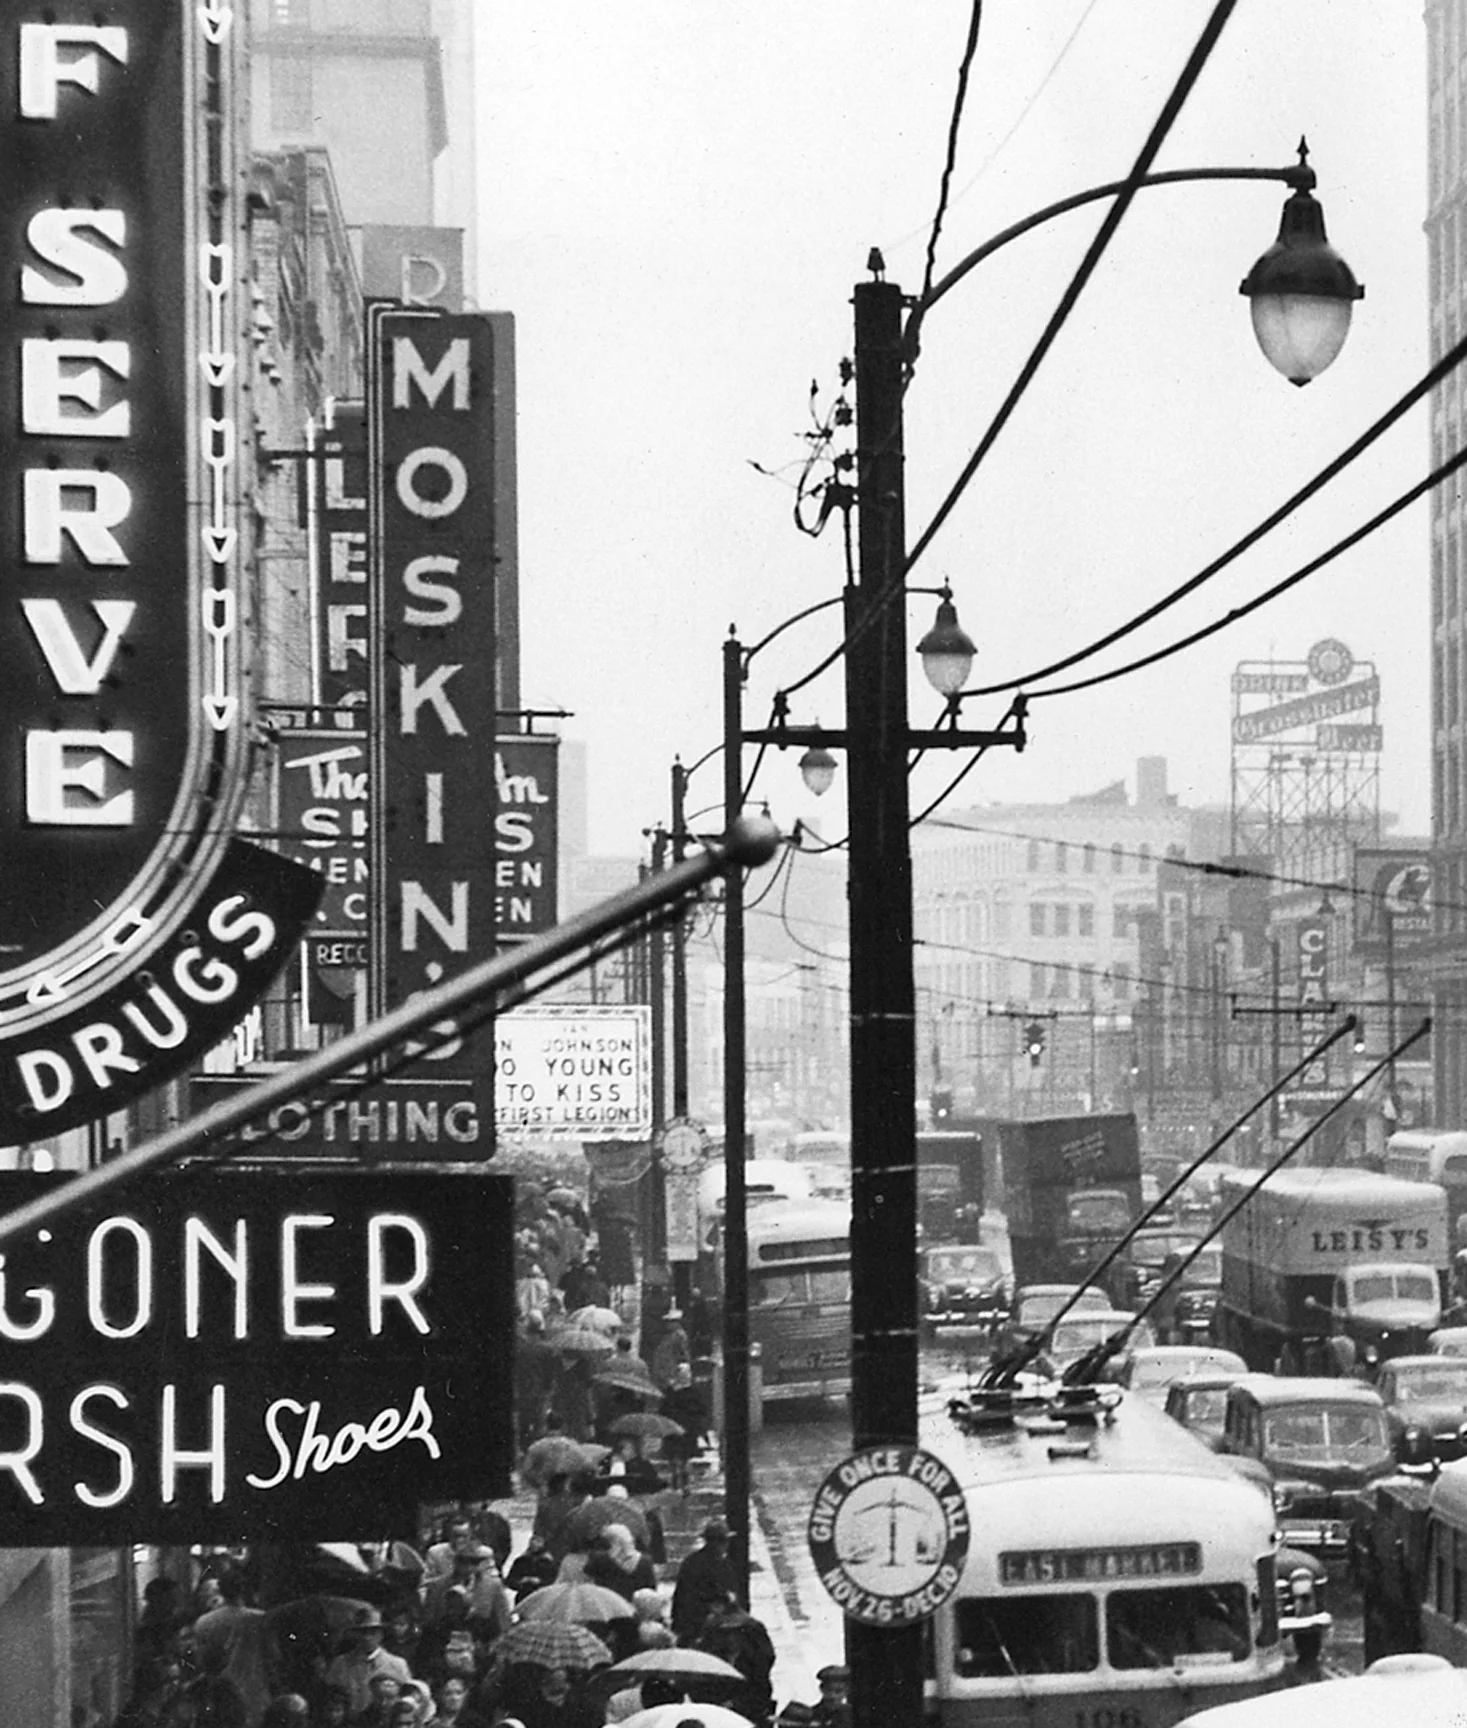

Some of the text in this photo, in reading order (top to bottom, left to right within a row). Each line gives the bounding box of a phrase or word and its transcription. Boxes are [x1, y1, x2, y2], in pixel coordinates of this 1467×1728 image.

[20, 207, 137, 826] SERVE
[16, 895, 276, 1112] DRUGS
[506, 1084, 621, 1102] TO KISS
[545, 1058, 633, 1077] YOUNG
[1311, 1228, 1429, 1252] LEISY'S
[246, 1385, 441, 1489] Shoes
[811, 1450, 968, 1543] GIVE ONCE FOR ALL
